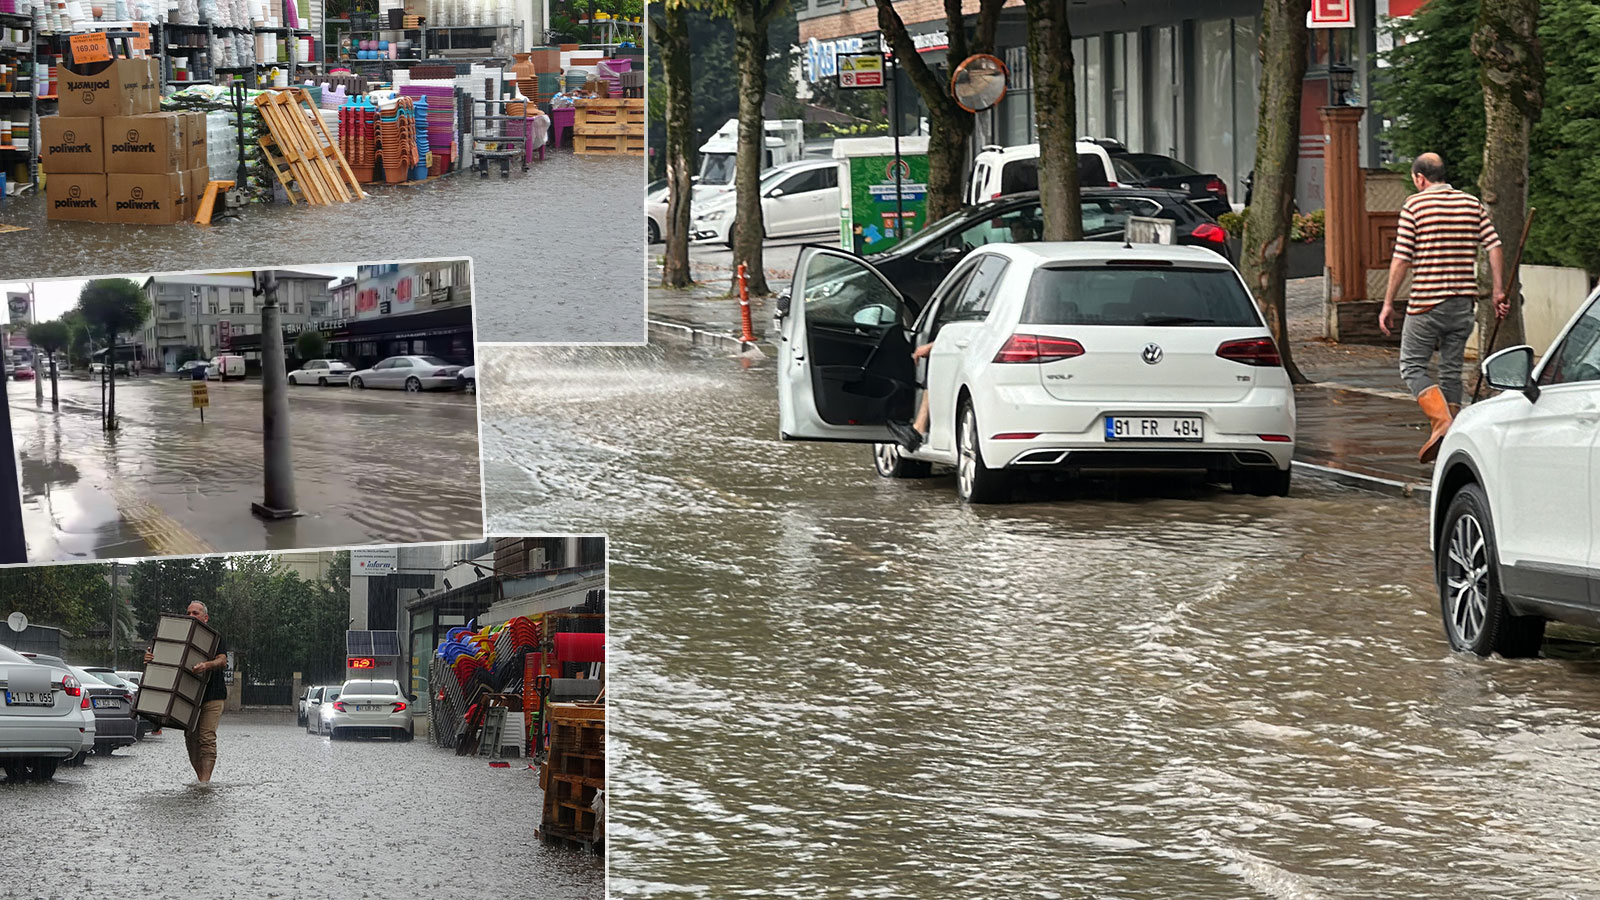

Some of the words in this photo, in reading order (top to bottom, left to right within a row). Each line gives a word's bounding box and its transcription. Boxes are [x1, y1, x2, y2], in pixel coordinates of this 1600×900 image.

[76, 43, 99, 53] 169,00
[67, 79, 110, 92] poliwork
[49, 142, 92, 155] poliwork
[112, 141, 156, 154] poliwork
[55, 197, 98, 210] poliwork
[116, 199, 160, 211] poliwork
[320, 318, 348, 331] LEZZET
[1115, 420, 1129, 436] 81
[1141, 420, 1159, 436] FR
[1173, 420, 1199, 436] 484
[366, 560, 391, 568] inform
[11, 691, 20, 701] 41
[25, 692, 35, 702] LR
[39, 693, 52, 703] 055
